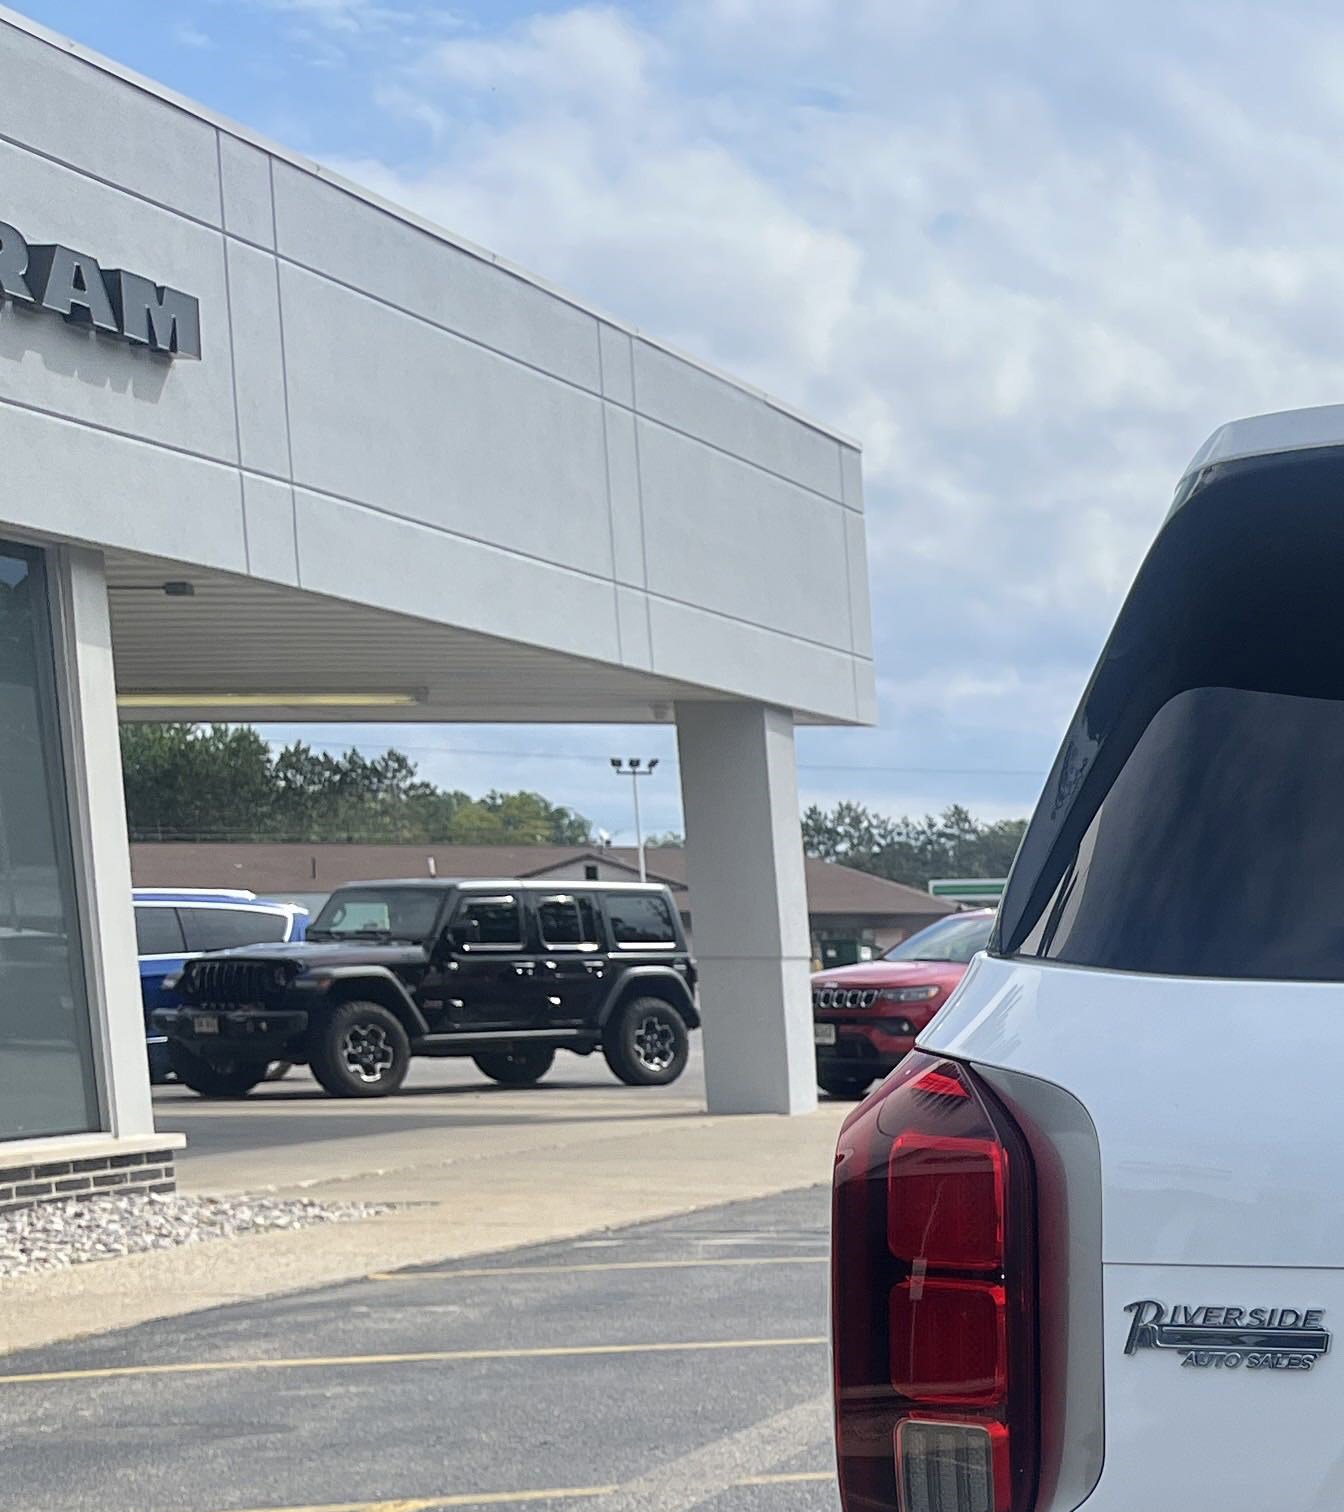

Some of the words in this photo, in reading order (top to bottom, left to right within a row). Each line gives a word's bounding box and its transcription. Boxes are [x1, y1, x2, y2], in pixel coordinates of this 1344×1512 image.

[1123, 1300, 1327, 1355] RIVERSIDE
[1180, 1351, 1243, 1369] AUTO
[1246, 1353, 1318, 1371] SALES
